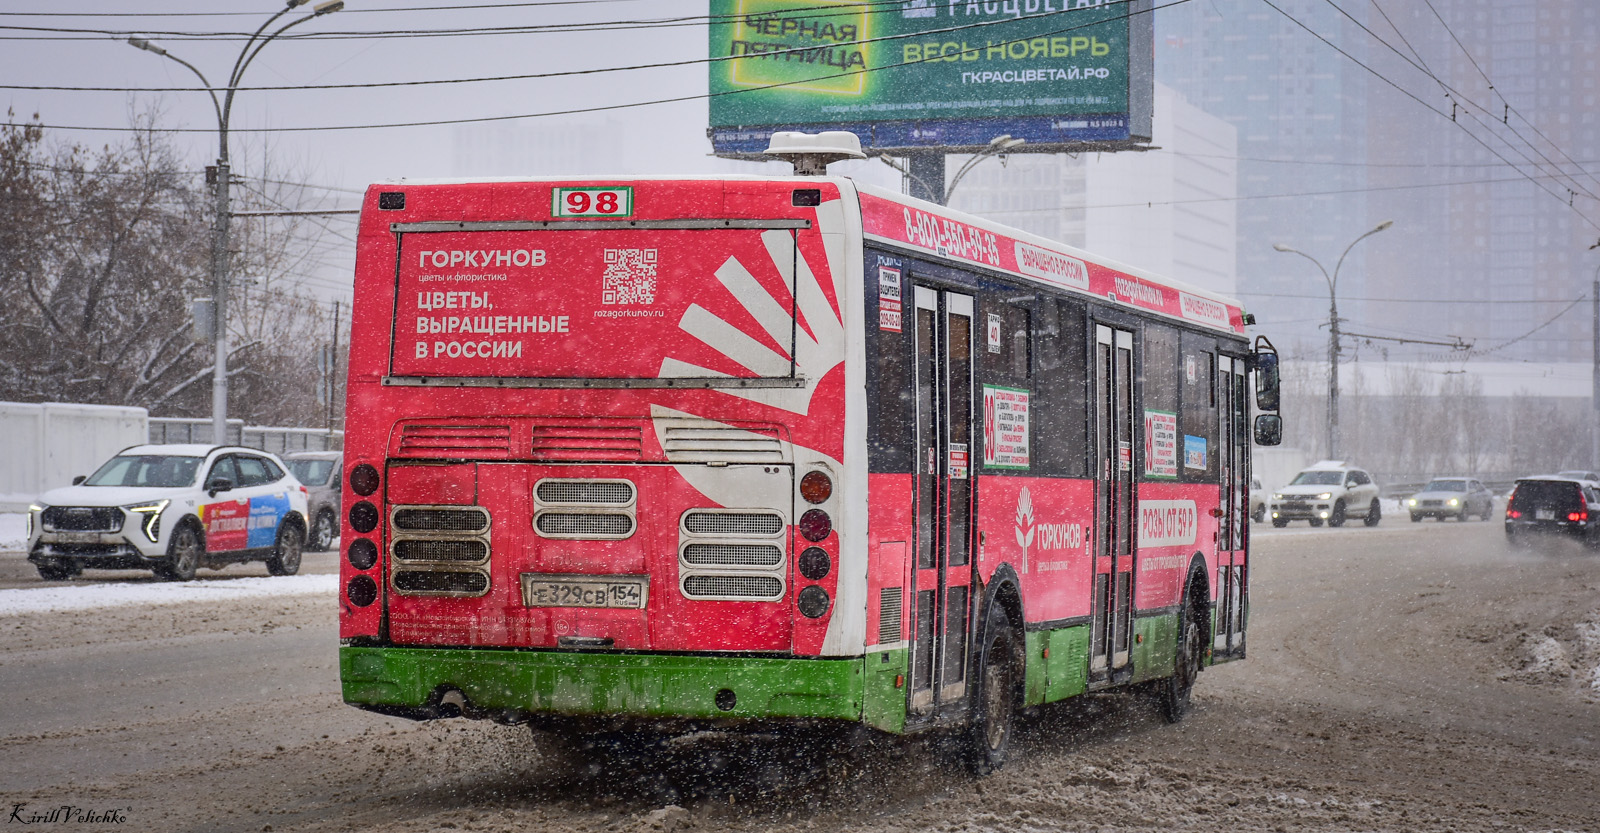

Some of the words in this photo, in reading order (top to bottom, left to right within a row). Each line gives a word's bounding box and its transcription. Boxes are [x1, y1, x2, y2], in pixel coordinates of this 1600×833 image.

[745, 12, 857, 41] ЧЁРНАЯ
[731, 40, 866, 71] ПЯТНИЦА
[903, 42, 980, 64] ВЕСЬ
[987, 36, 1110, 60] НОЯБРЬ
[962, 66, 1110, 84] ГКРАСЦВЕТАЙ.РФ
[566, 192, 619, 214] 98
[903, 207, 1000, 266] 8-800-550-59-35
[419, 249, 547, 267] ГОРКУНОВ
[1021, 247, 1055, 274] ВЫРАЩЕНО
[1059, 258, 1084, 282] РОССИИ
[418, 275, 445, 283] цветы
[454, 272, 507, 283] флористика
[417, 291, 493, 311] ЦВЕТЫ,
[1114, 277, 1164, 307] rozagorkunov.ru
[416, 316, 570, 336] ВЫРАЩЕННЫЕ
[594, 309, 664, 319] rozagorkunov.ru
[415, 341, 428, 359] В
[434, 341, 522, 359] РОССИИ
[984, 394, 995, 461] 98
[1145, 416, 1153, 472] 98
[1037, 523, 1081, 550] ГОРКУНОВ
[1142, 508, 1165, 539] РОЗЫ
[1167, 508, 1177, 538] ОТ
[1178, 508, 1187, 537] 59
[610, 585, 639, 600] 154
